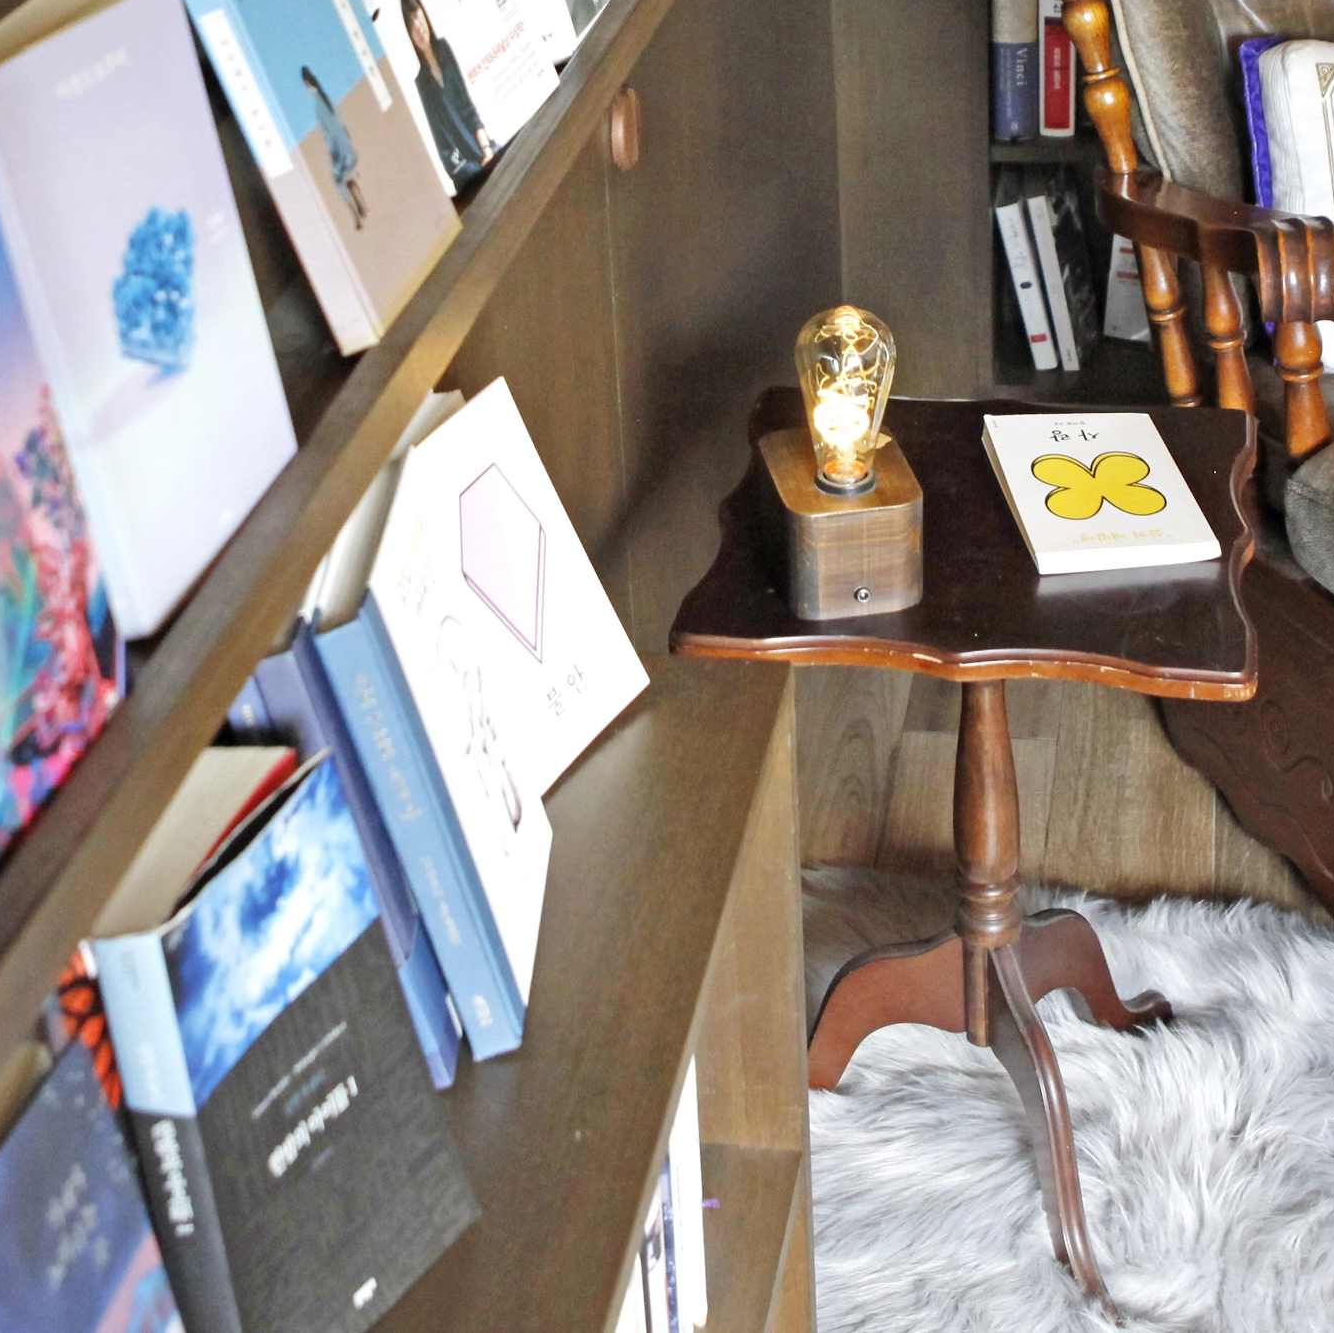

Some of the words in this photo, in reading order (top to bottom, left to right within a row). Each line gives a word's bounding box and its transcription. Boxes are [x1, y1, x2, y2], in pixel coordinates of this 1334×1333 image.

[1015, 46, 1029, 86] Vinci
[1050, 429, 1101, 443] 사랑
[546, 664, 589, 717] 불안
